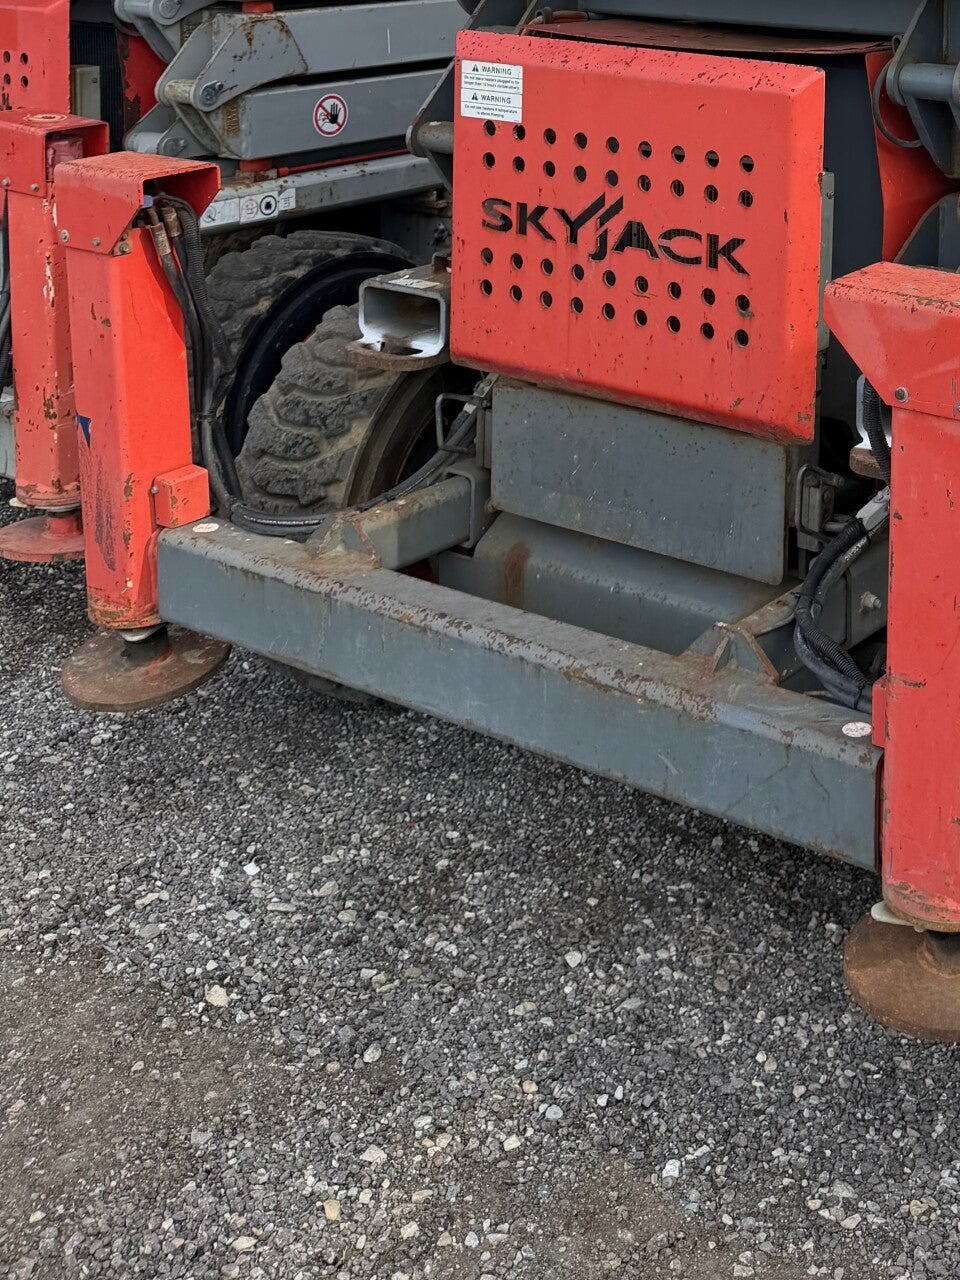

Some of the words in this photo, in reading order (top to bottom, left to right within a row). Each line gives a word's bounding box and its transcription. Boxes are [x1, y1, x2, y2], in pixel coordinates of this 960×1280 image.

[481, 65, 512, 76] WARNING
[480, 94, 511, 105] WARNING
[482, 192, 750, 277] SKYJACK
